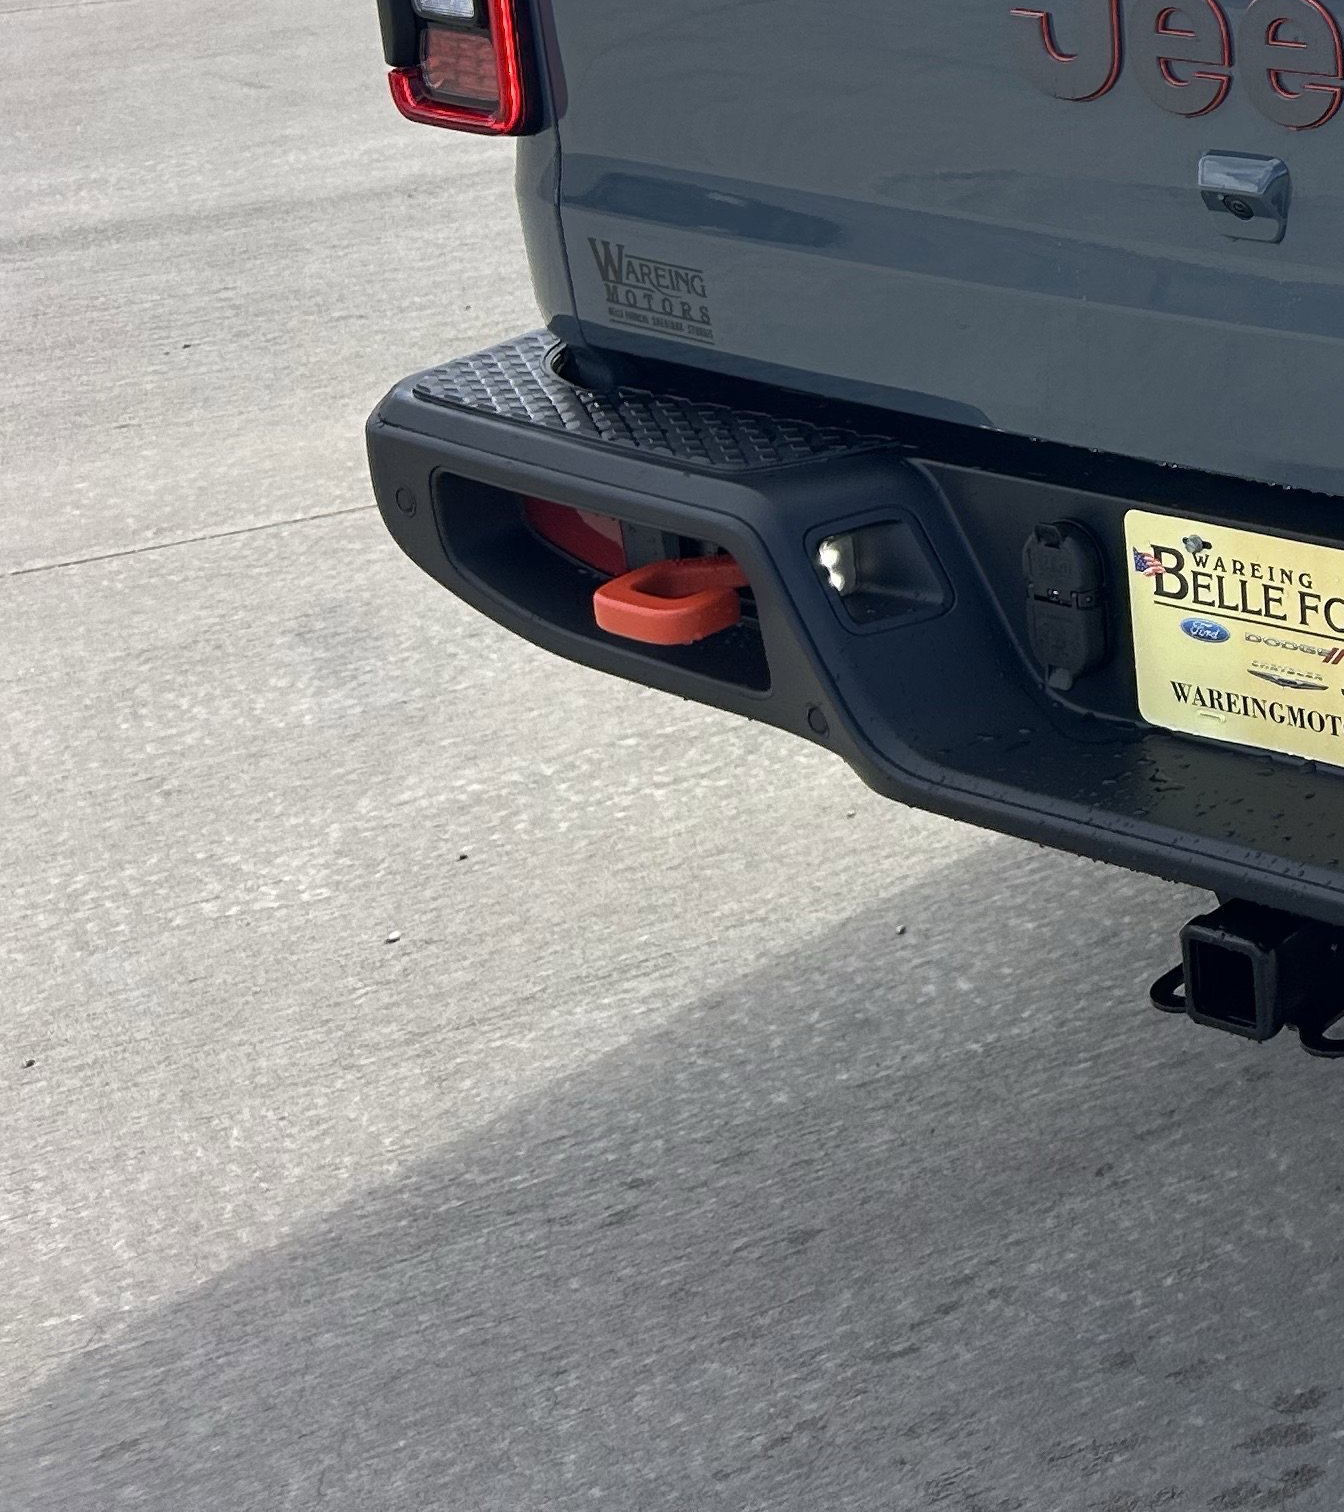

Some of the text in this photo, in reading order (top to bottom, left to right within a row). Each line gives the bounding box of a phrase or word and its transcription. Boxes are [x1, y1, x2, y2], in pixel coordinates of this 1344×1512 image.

[588, 236, 708, 299] WAREING
[604, 283, 712, 325] MOTORS
[1150, 543, 1288, 622] BELLE
[1193, 553, 1314, 589] WAREING
[1188, 620, 1222, 641] Ford
[1245, 632, 1333, 658] DODGE
